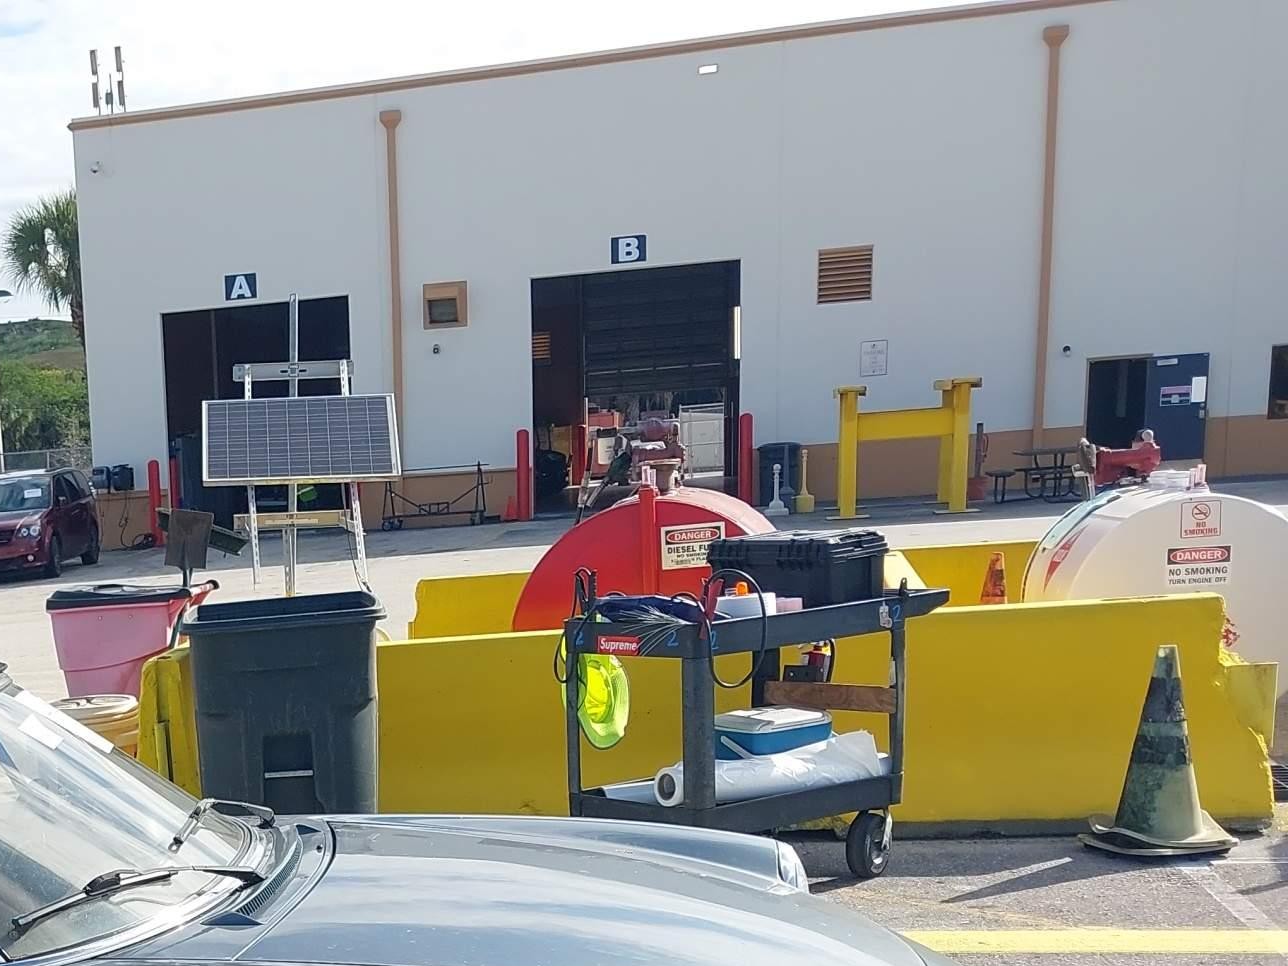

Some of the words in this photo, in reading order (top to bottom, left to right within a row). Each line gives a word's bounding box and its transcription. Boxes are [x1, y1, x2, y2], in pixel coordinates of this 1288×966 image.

[619, 238, 639, 261] B
[231, 276, 252, 298] A
[674, 531, 711, 540] DANGER
[1184, 528, 1218, 536] SMOKING
[667, 545, 696, 554] DIESEL
[699, 544, 710, 552] FU
[1176, 550, 1222, 561] DANGER
[1169, 568, 1181, 576] NO
[1184, 566, 1228, 576] SMOKING
[1188, 577, 1212, 585] ENGINE
[893, 605, 904, 622] 2
[600, 637, 638, 652] Supreme
[667, 631, 678, 647] 2
